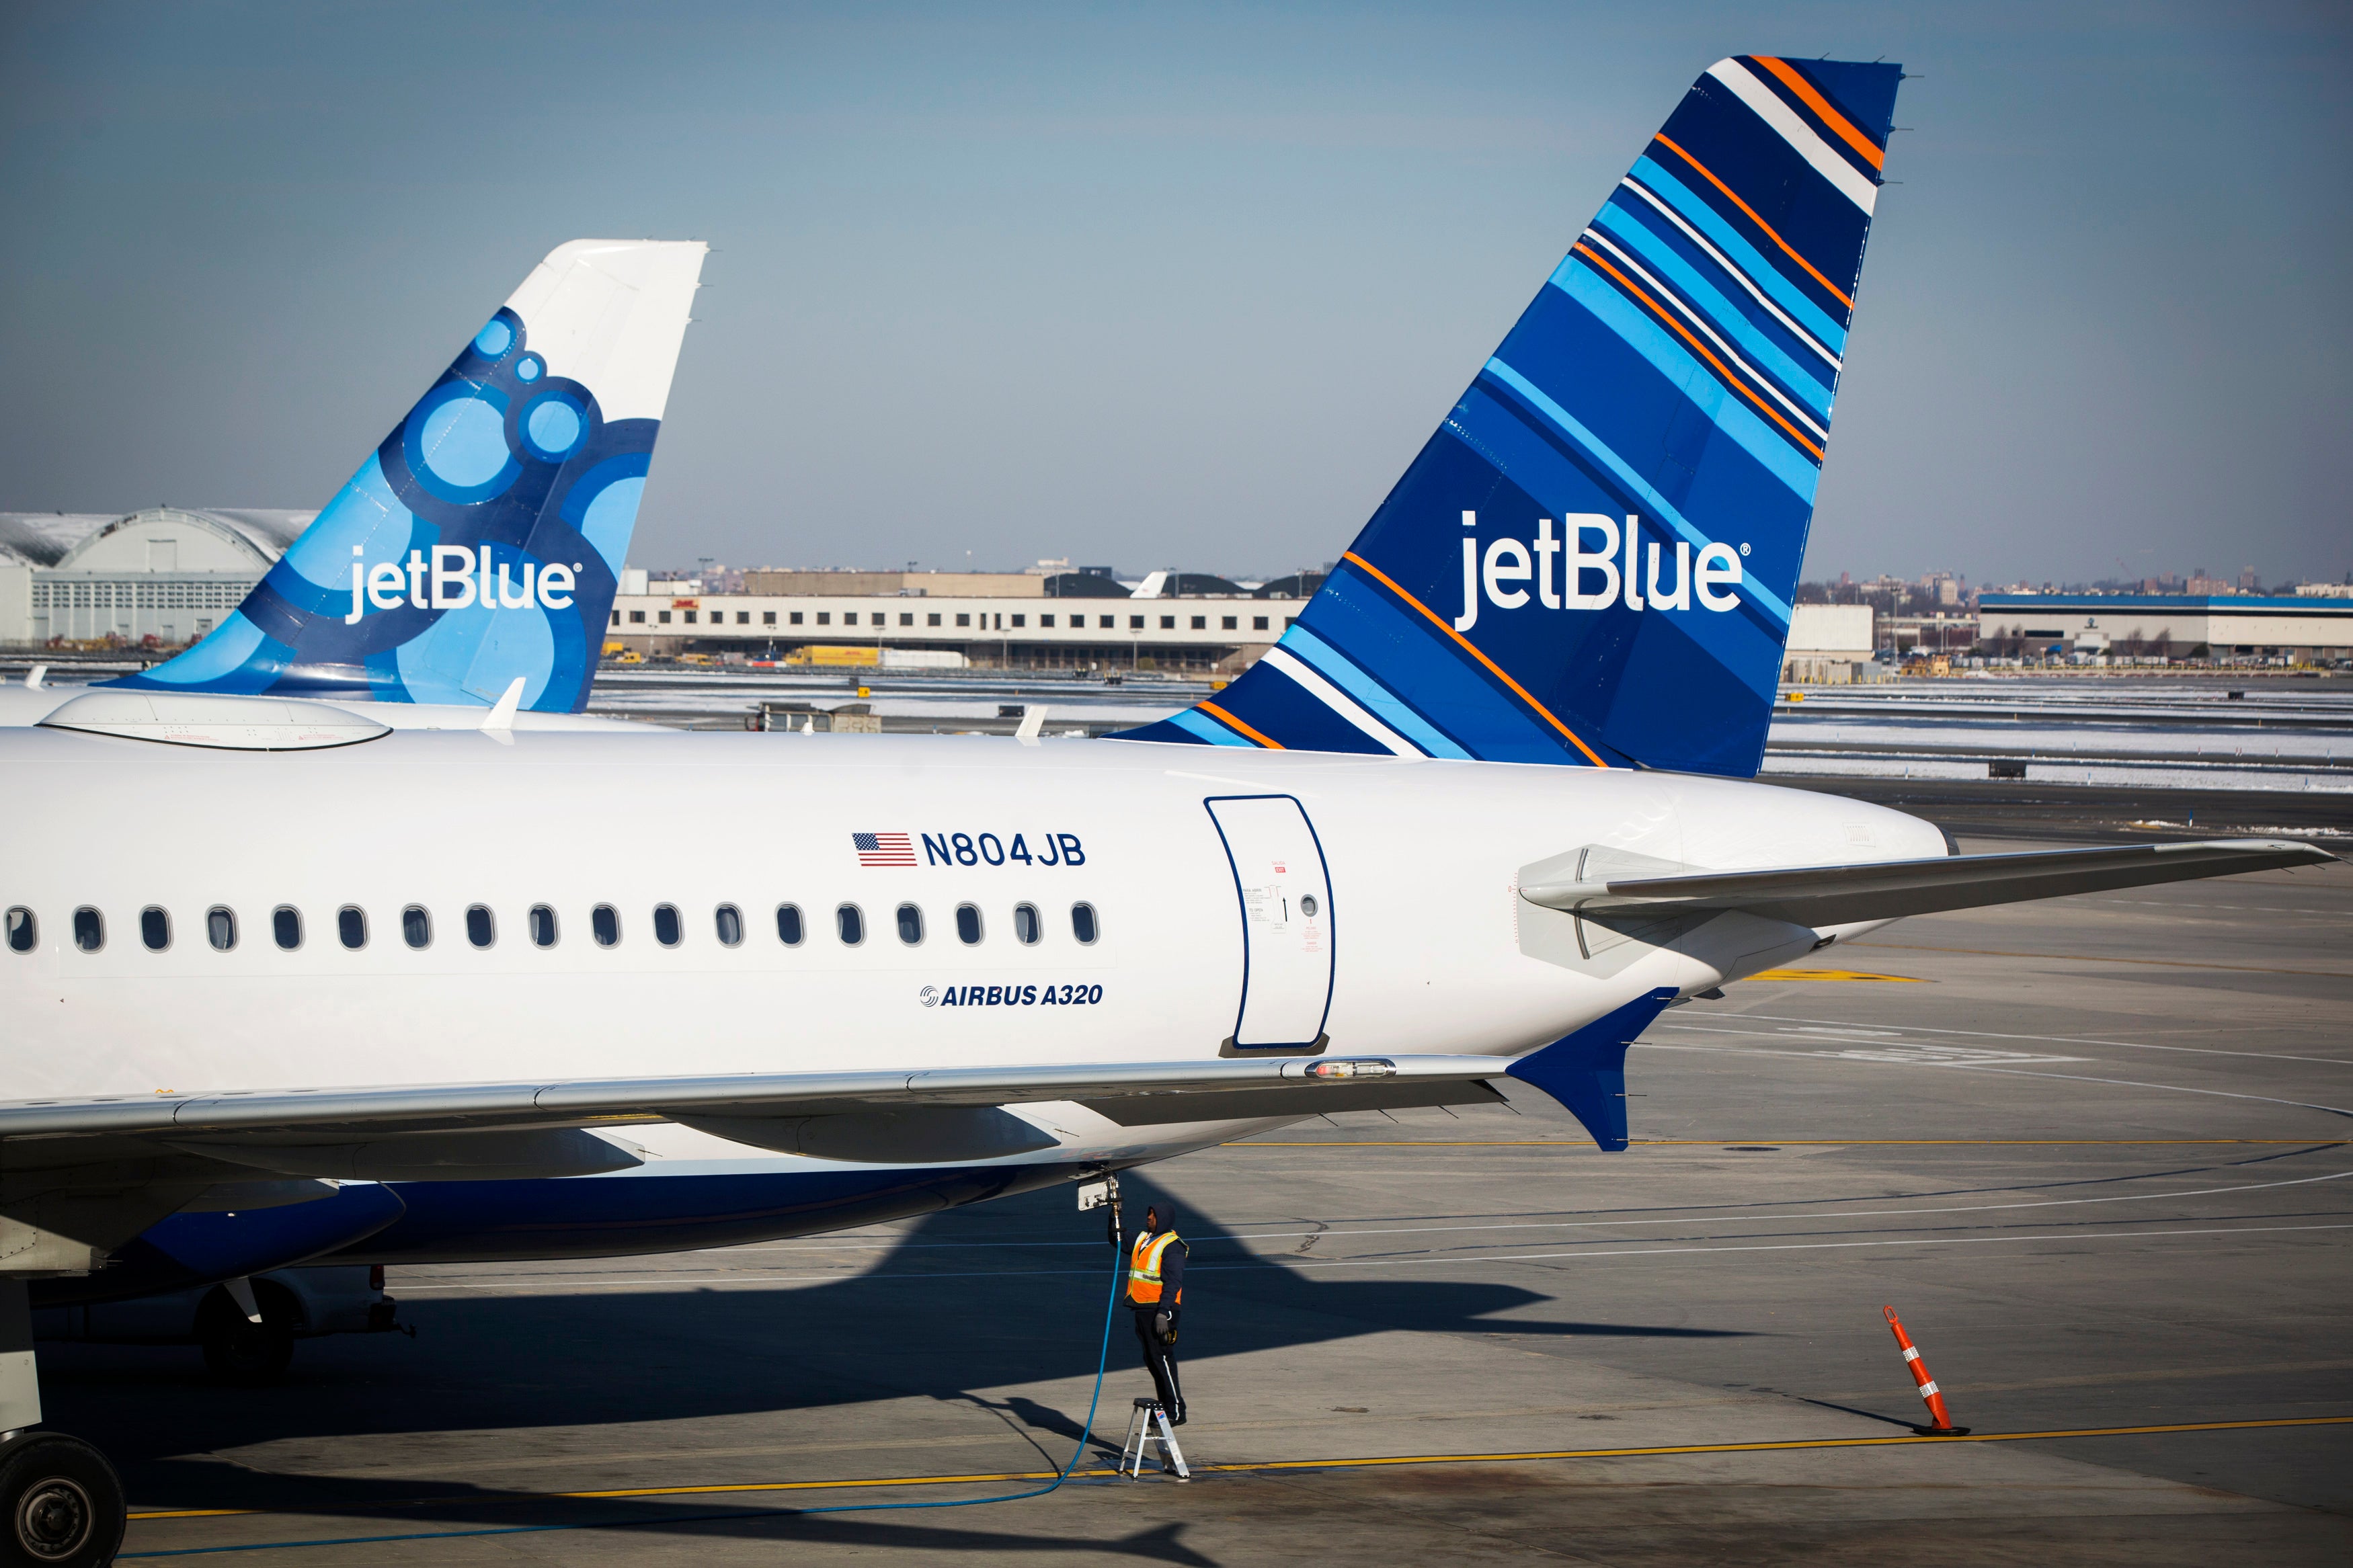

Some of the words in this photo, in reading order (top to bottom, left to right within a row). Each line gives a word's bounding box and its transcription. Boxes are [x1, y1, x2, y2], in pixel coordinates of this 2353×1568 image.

[920, 832, 1086, 866] N804JB
[940, 985, 1037, 1006] AIRBUS
[1040, 984, 1103, 1005] A320
